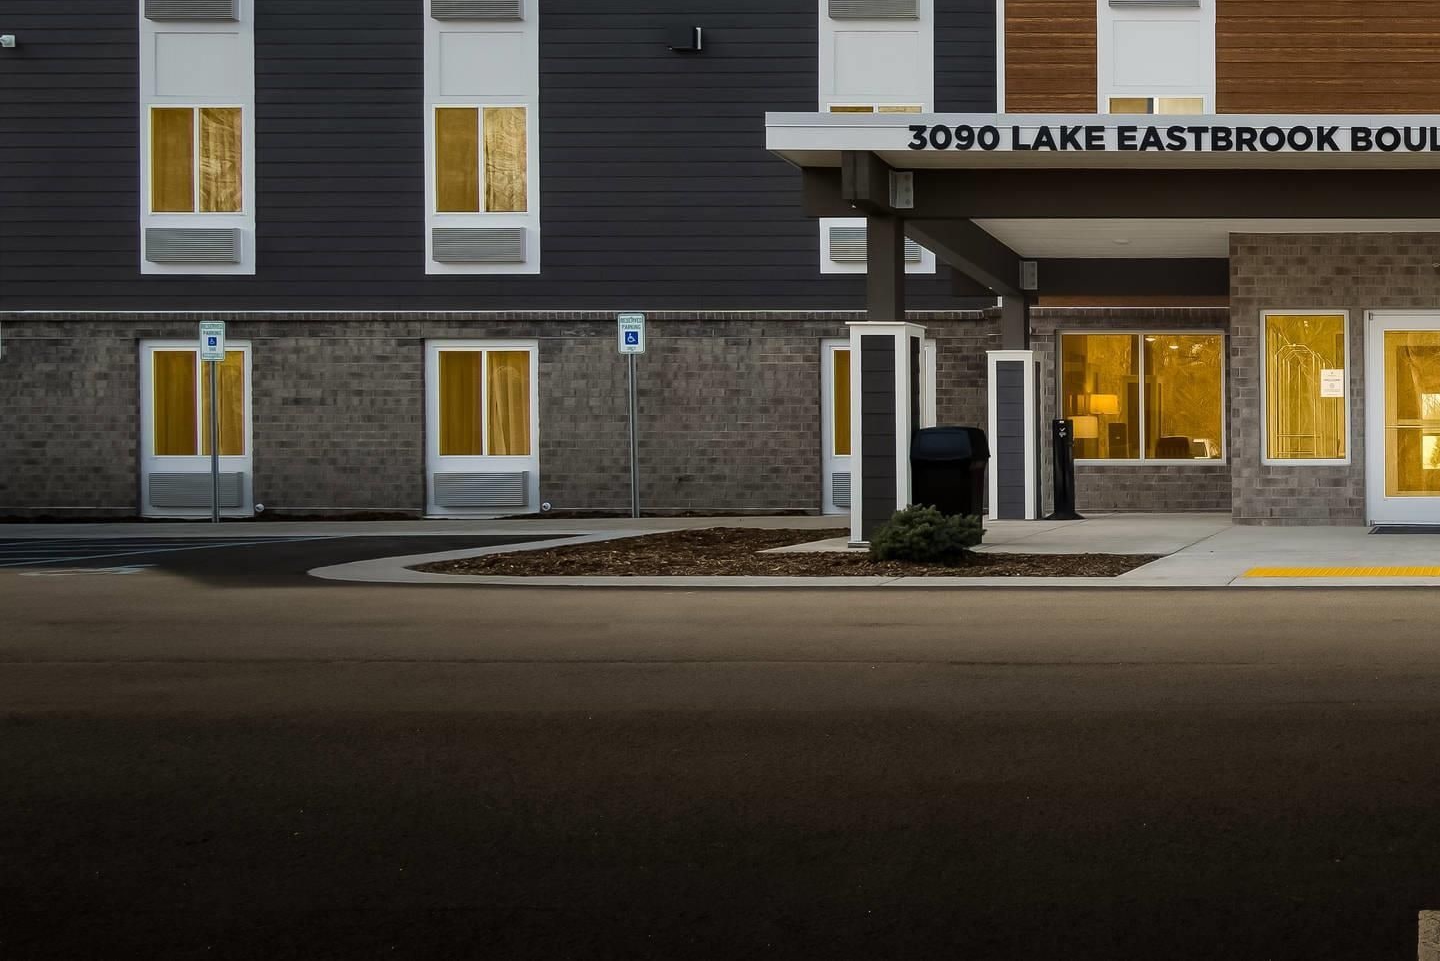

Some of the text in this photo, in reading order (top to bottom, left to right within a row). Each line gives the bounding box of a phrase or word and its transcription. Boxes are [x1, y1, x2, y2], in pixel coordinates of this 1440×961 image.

[907, 125, 1001, 151] 3090
[1012, 125, 1106, 151] LAKE
[1117, 125, 1340, 151] EASTBROOK
